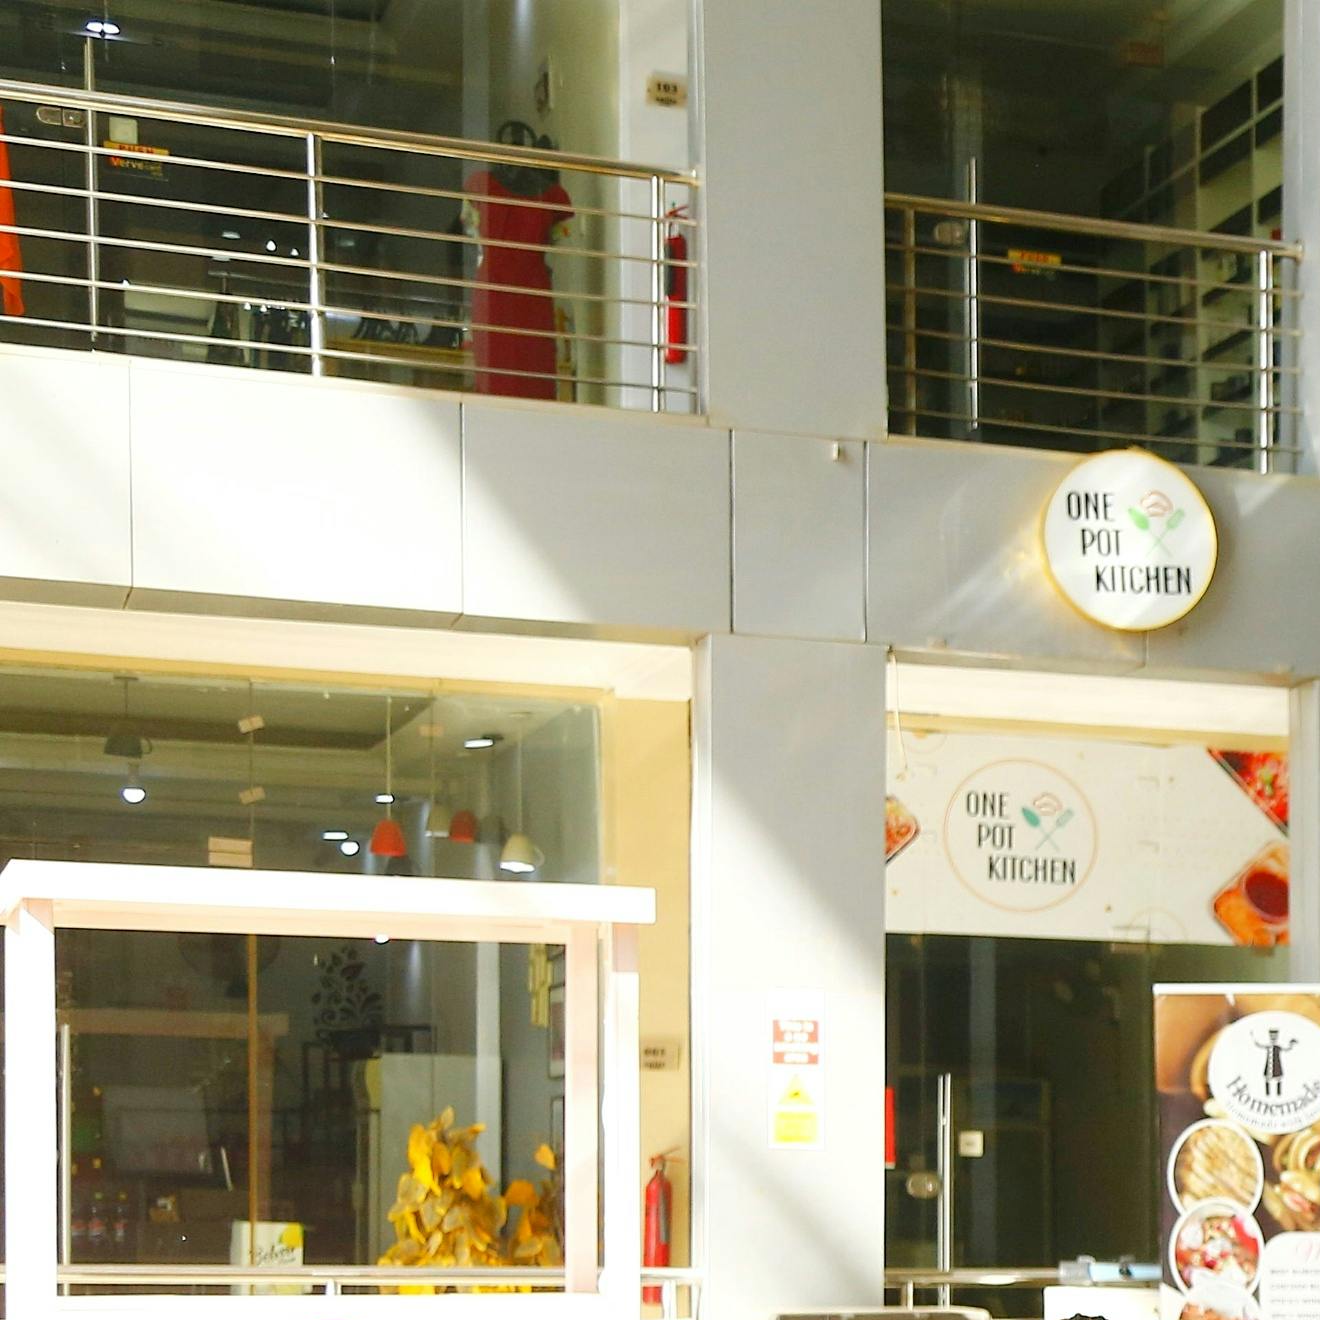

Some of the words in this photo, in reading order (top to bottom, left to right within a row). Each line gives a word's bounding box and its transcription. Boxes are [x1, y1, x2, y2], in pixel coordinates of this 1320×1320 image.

[1067, 491, 1114, 521] ONE
[1081, 528, 1122, 557] POT
[1095, 564, 1192, 595] KITCHEN
[966, 791, 1010, 819] ONE
[977, 823, 1015, 850] POT
[988, 855, 1076, 885] KITCHEN
